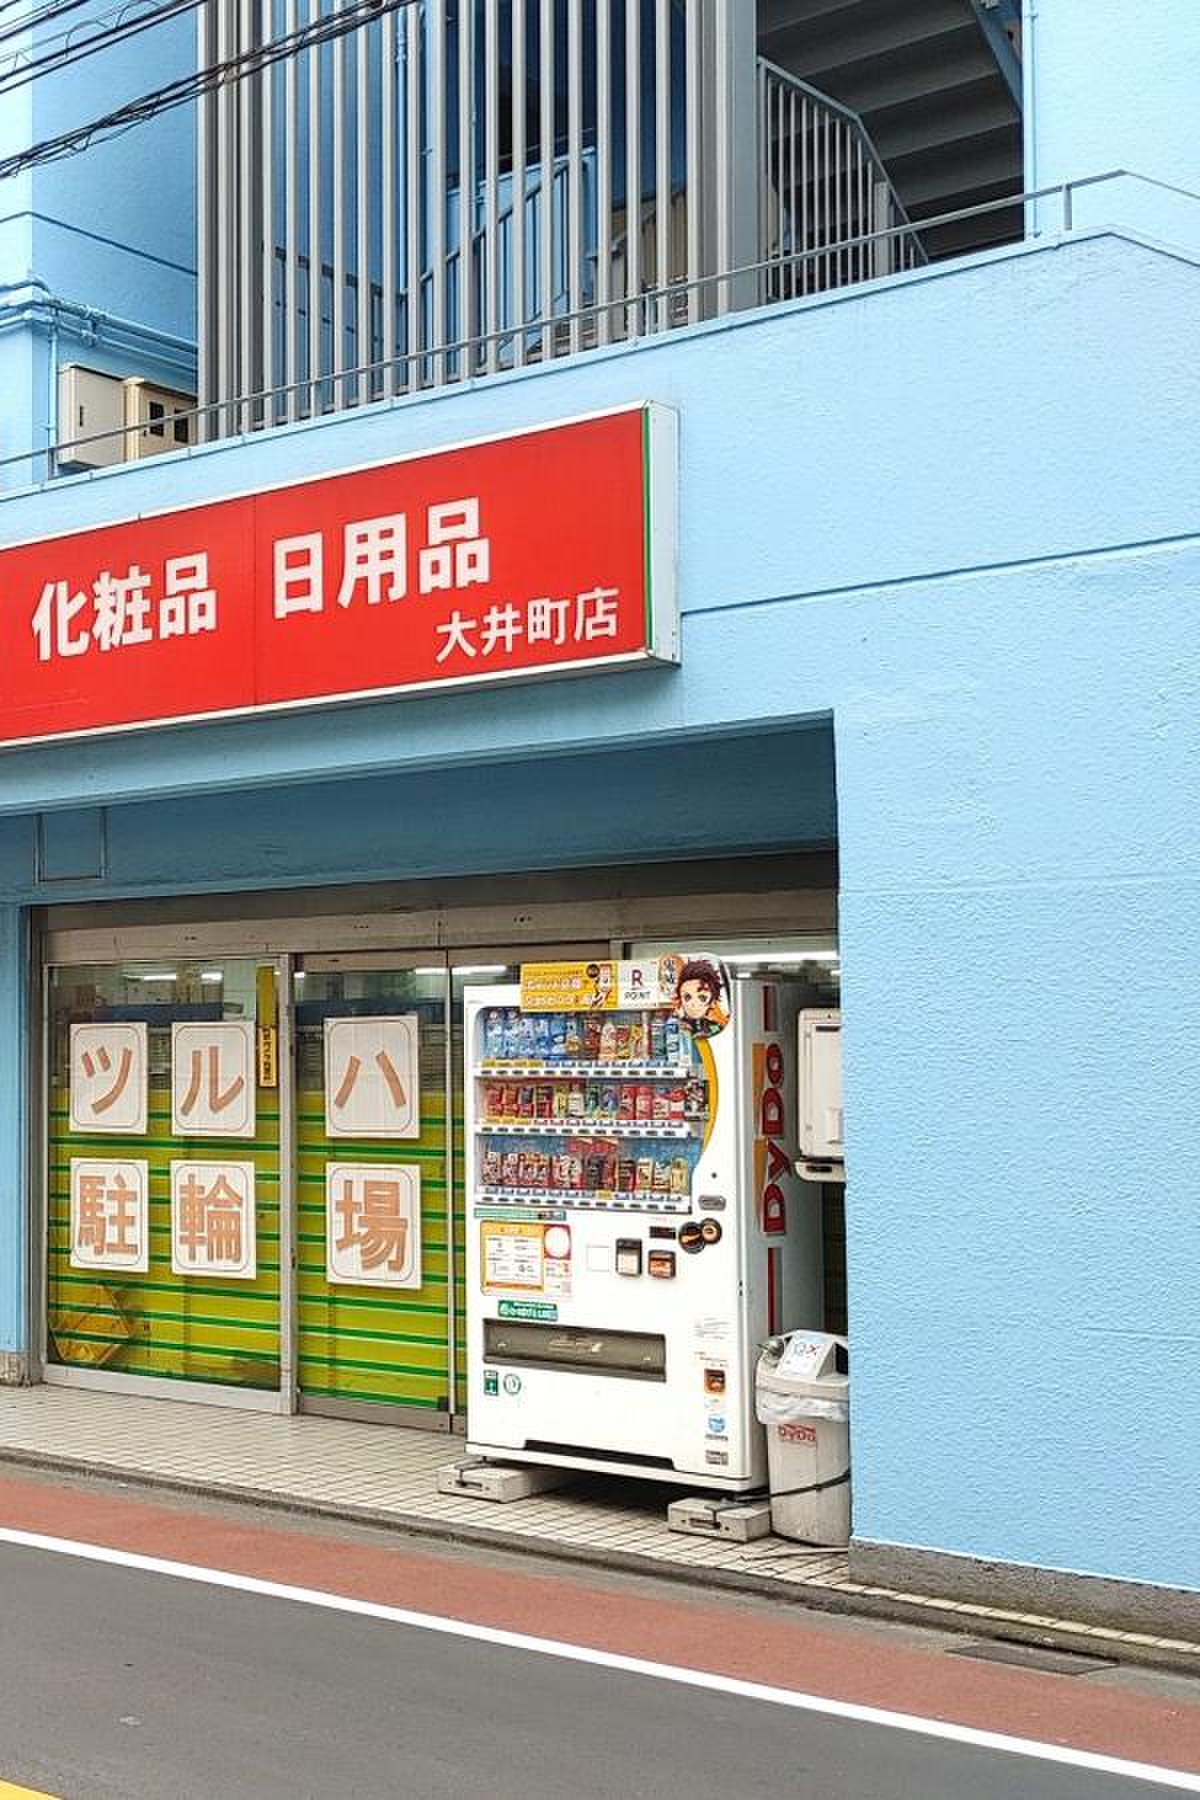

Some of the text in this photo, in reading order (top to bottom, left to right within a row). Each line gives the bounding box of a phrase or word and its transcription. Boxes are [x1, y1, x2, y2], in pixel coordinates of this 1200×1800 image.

[32, 553, 217, 662] 化粧品
[272, 497, 490, 619] 日用品
[435, 588, 619, 663] 大井町店
